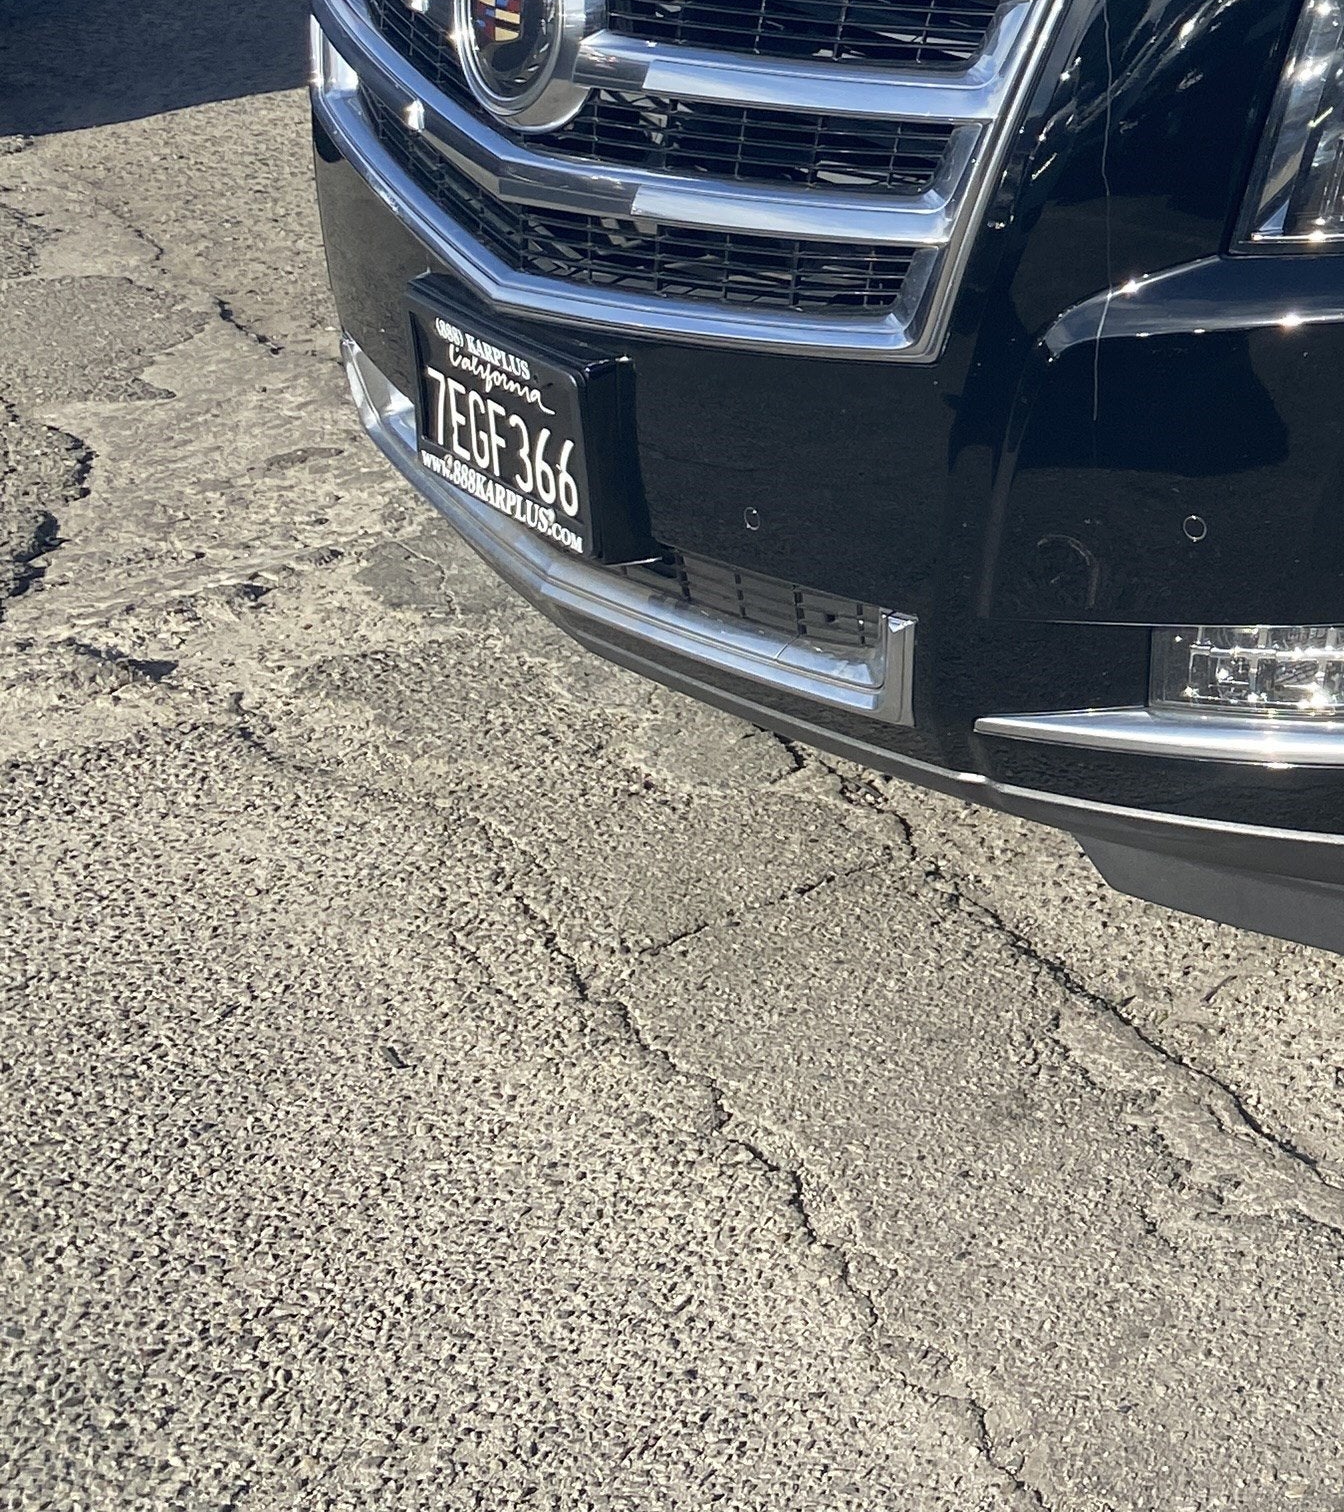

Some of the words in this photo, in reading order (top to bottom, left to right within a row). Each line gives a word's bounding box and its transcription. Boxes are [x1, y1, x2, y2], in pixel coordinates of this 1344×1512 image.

[435, 317, 464, 348] (888)
[465, 333, 530, 380] KARPLUS
[449, 344, 555, 415] California
[427, 365, 579, 517] 7EGF366
